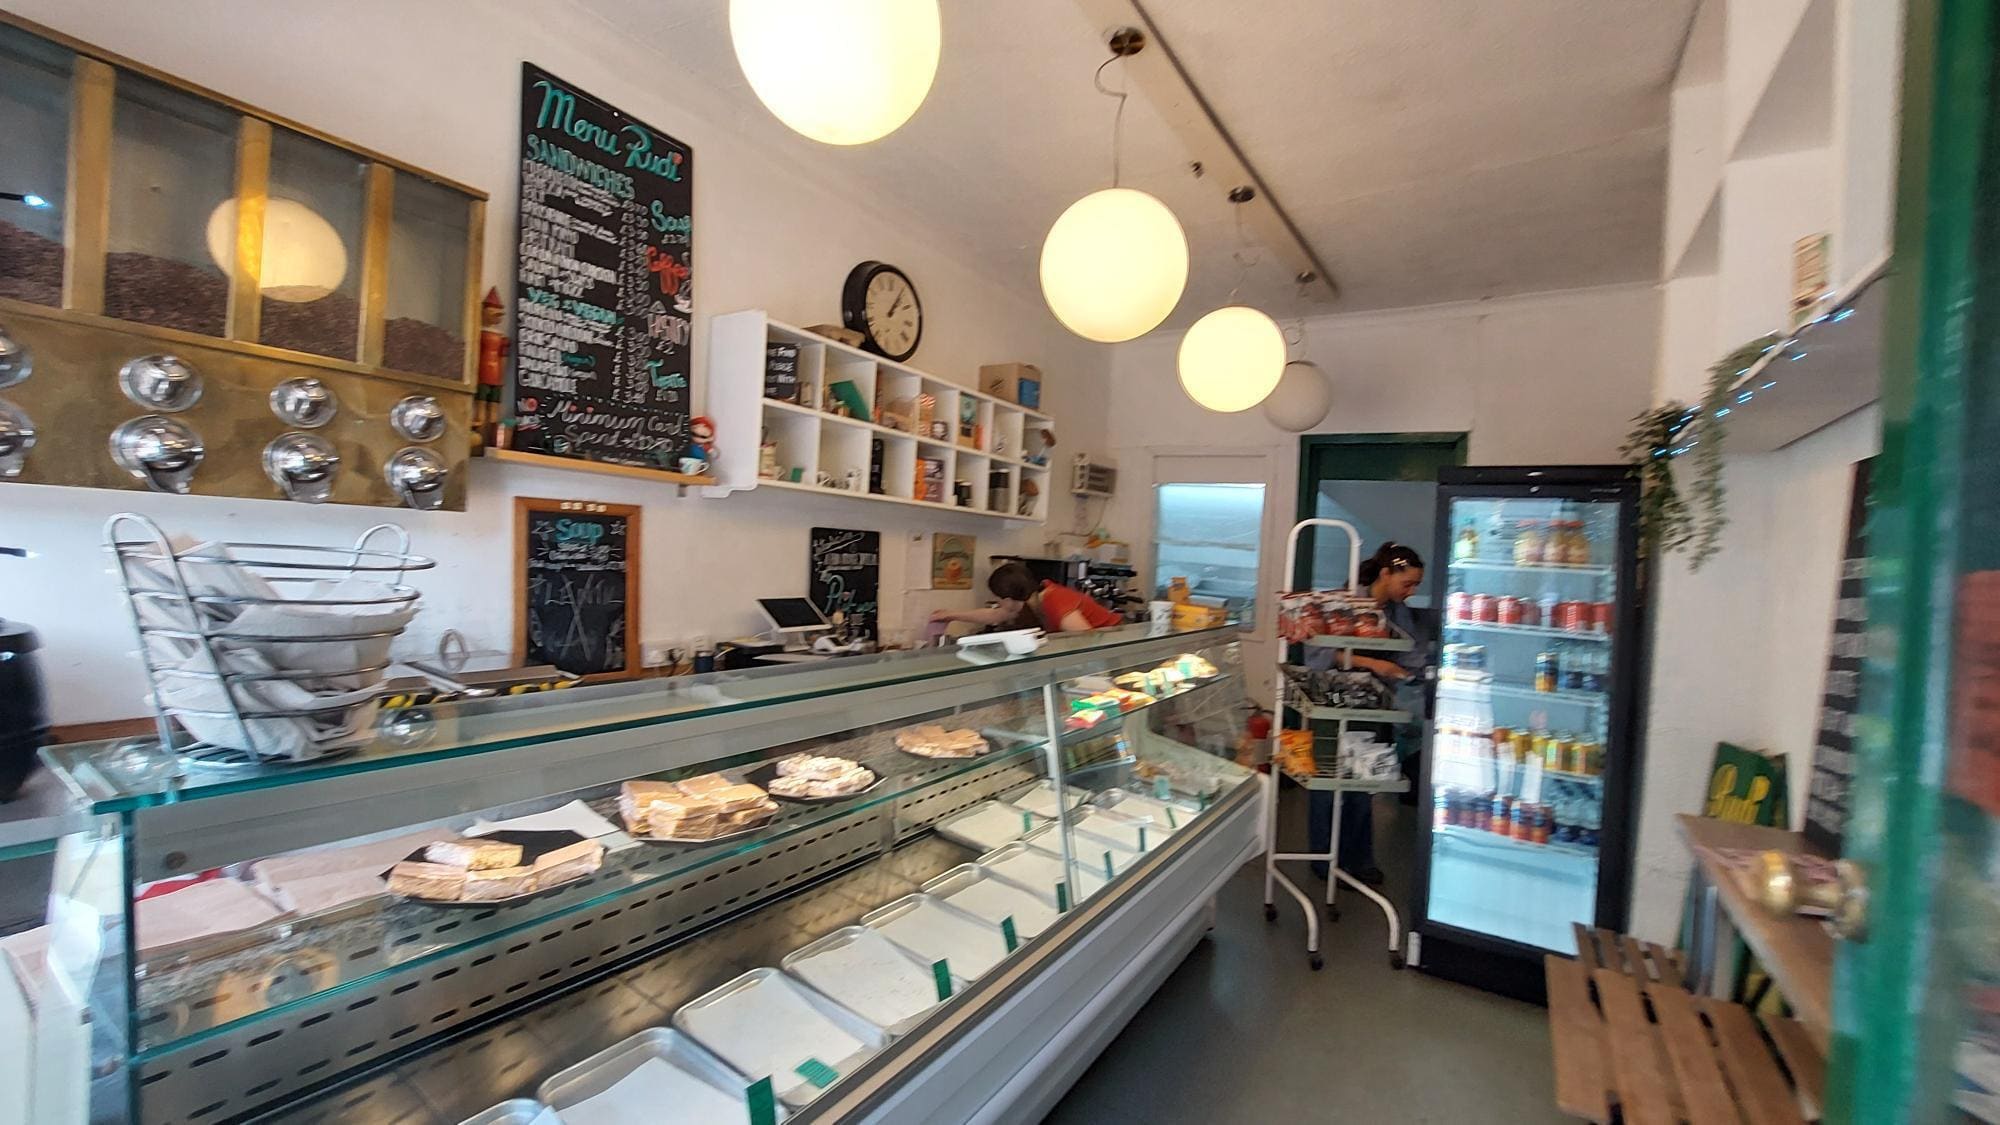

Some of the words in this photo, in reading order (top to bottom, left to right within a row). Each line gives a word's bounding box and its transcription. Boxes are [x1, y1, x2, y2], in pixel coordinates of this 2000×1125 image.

[533, 80, 621, 155] Menu
[621, 124, 683, 182] Rudi
[554, 518, 605, 544] Soup
